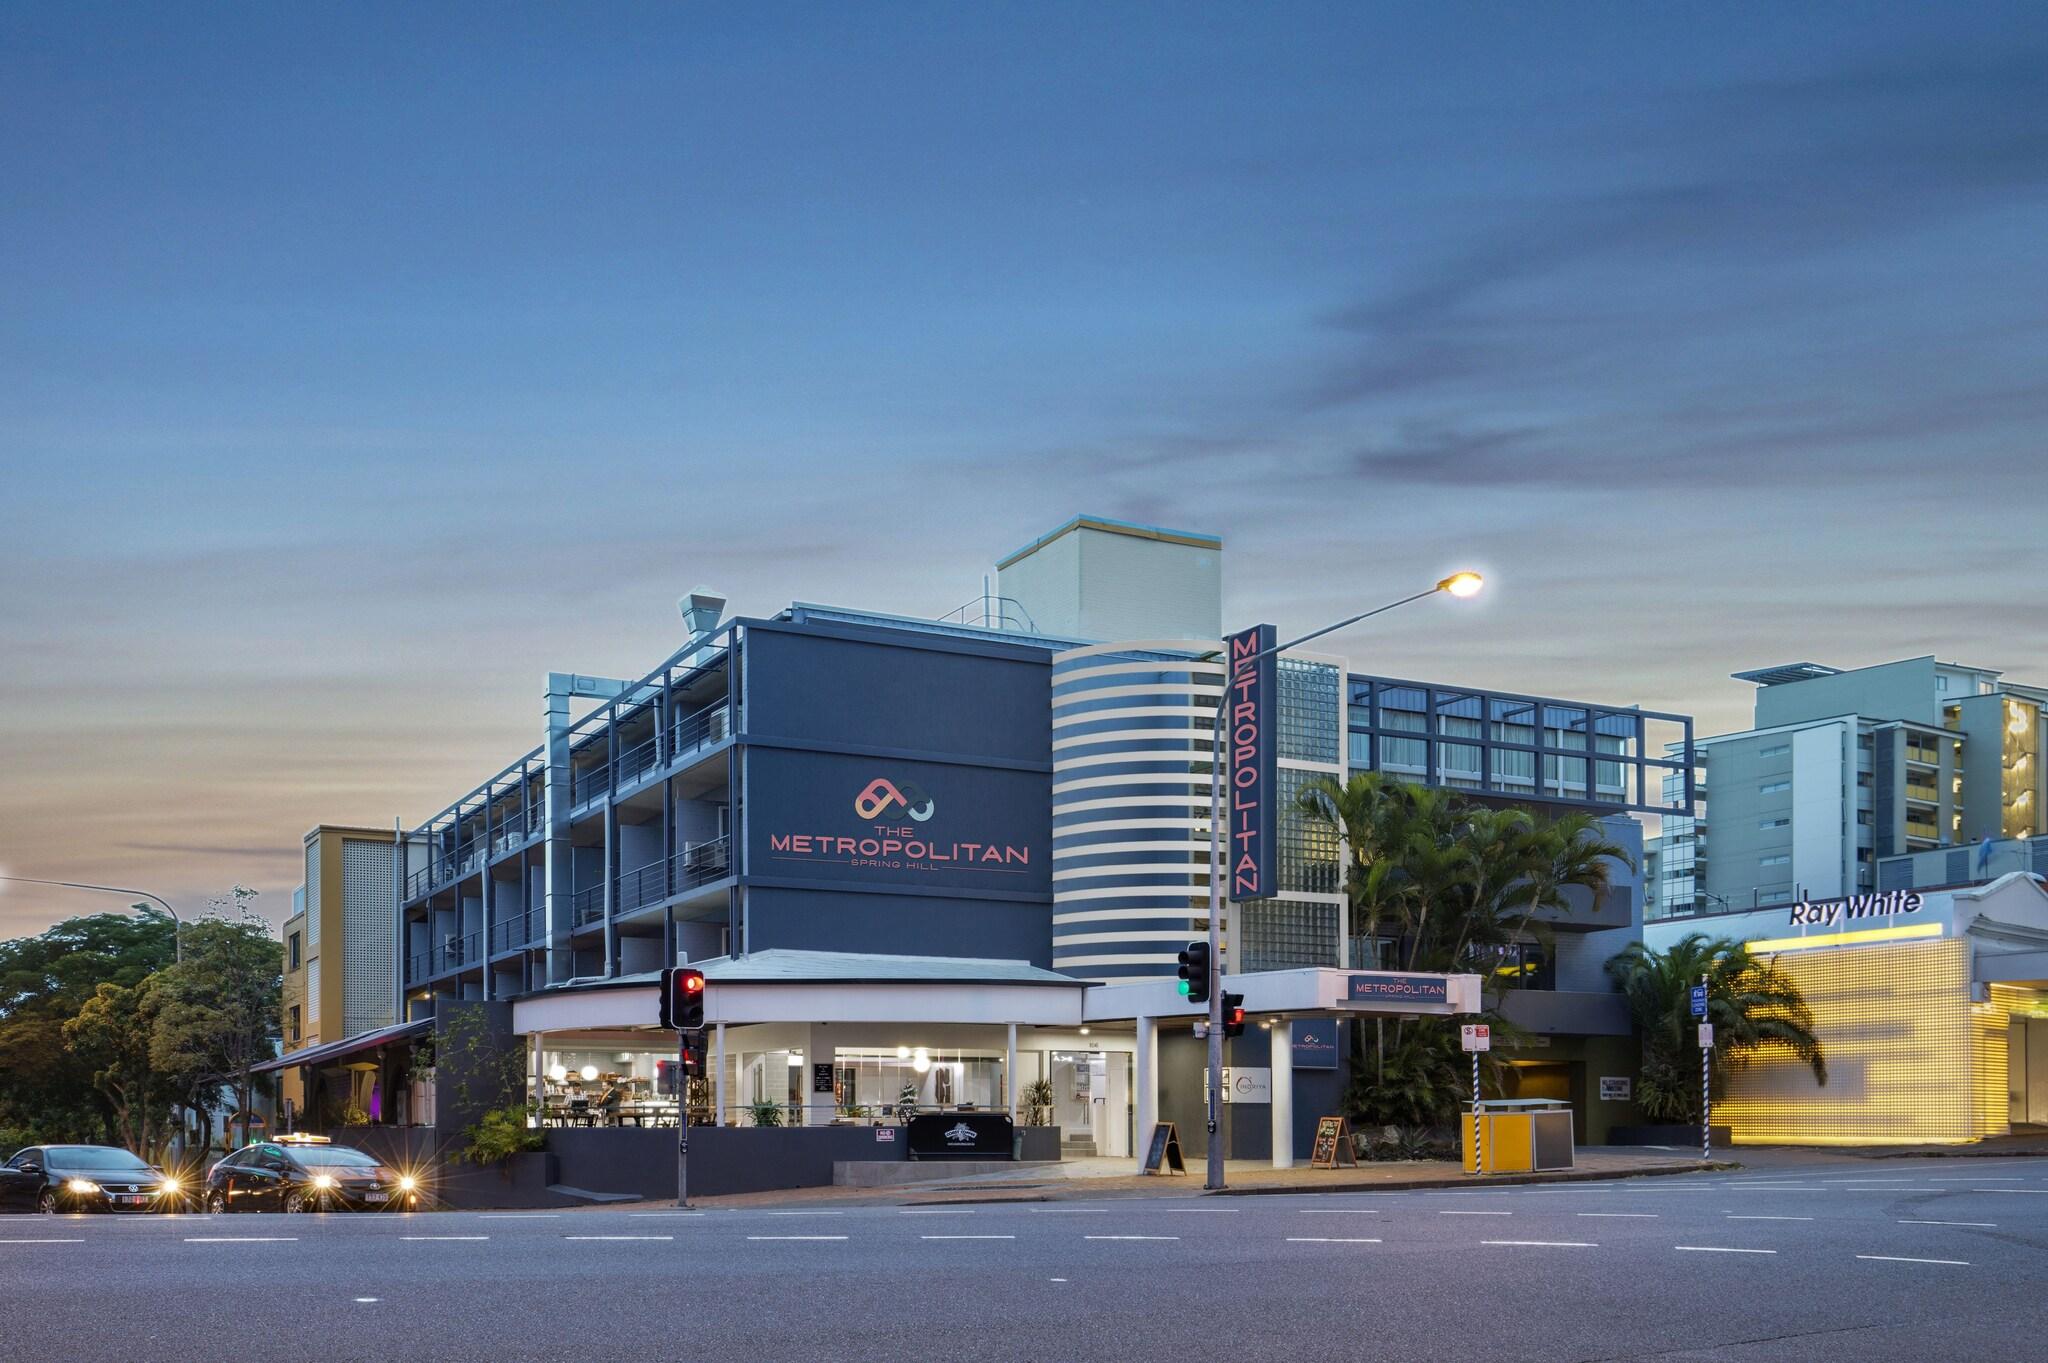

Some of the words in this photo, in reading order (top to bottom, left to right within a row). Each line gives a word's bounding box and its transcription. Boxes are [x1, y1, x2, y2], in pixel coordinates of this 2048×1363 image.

[1234, 631, 1258, 894] METROPOLITAN
[873, 825, 914, 838] THE
[770, 833, 1028, 865] METROPOLITAN
[850, 858, 901, 868] SPRING
[906, 862, 939, 871] HILL
[1789, 902, 1842, 927] Ray
[1847, 890, 1923, 919] White
[1356, 983, 1445, 995] METROPOLITAN
